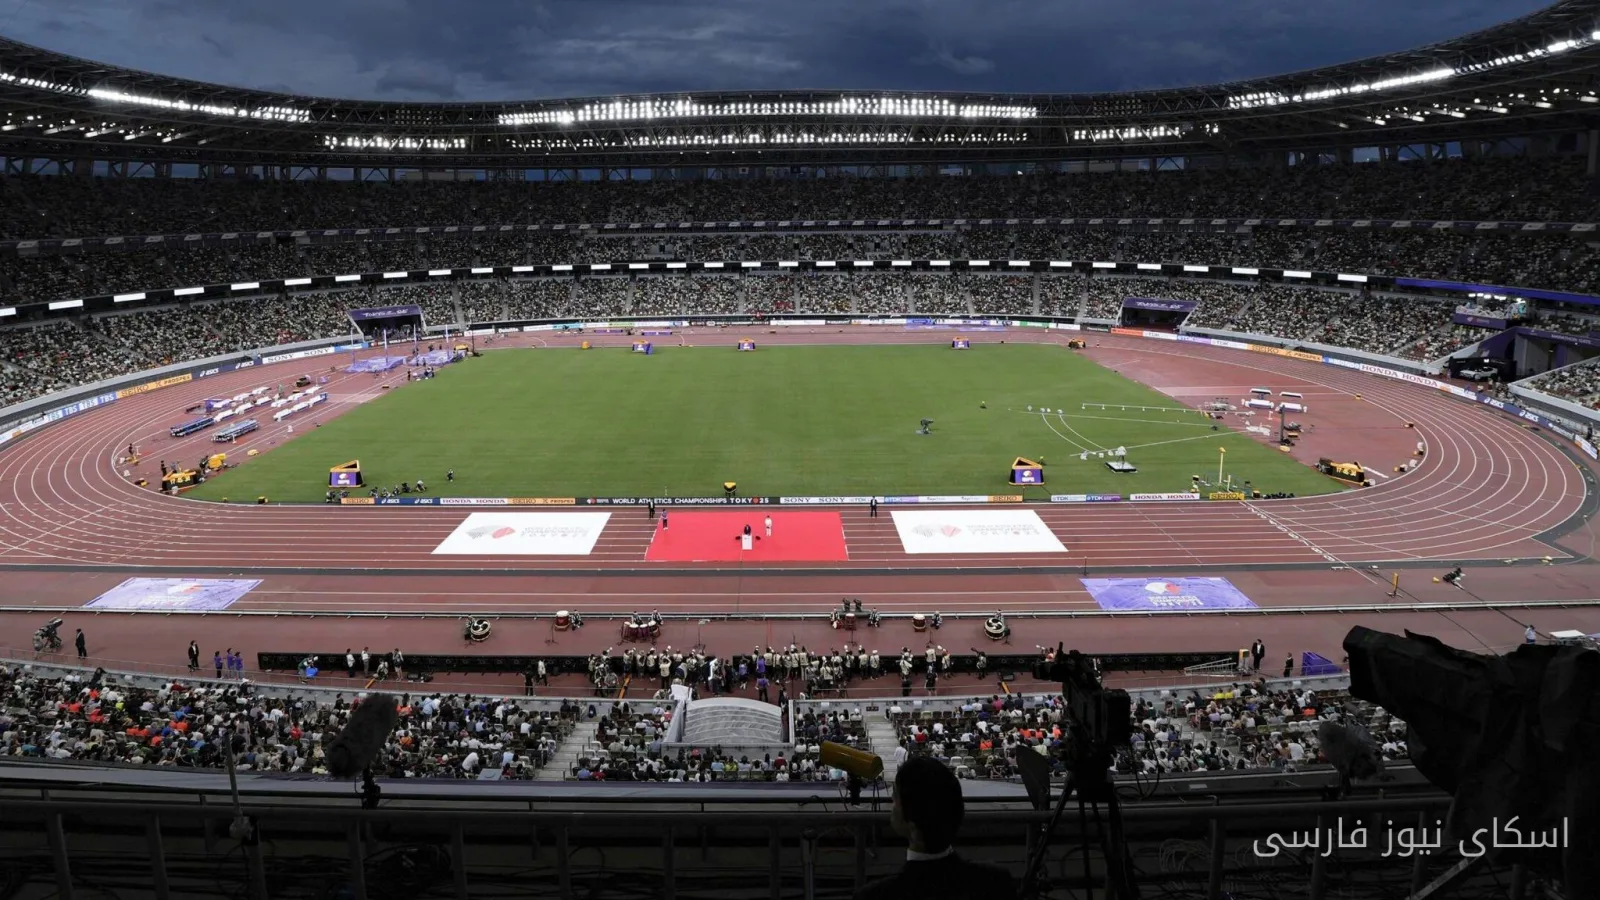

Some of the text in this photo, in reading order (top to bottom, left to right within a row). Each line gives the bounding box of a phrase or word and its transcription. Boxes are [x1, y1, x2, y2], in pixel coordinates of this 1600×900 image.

[268, 354, 293, 362] SONY
[304, 348, 329, 356] SONY
[1252, 344, 1279, 354] SEIKO
[1361, 364, 1438, 387] HONDA HONDA
[121, 385, 149, 397] SEIKO
[64, 405, 77, 415] TBS
[100, 393, 114, 403] TBS
